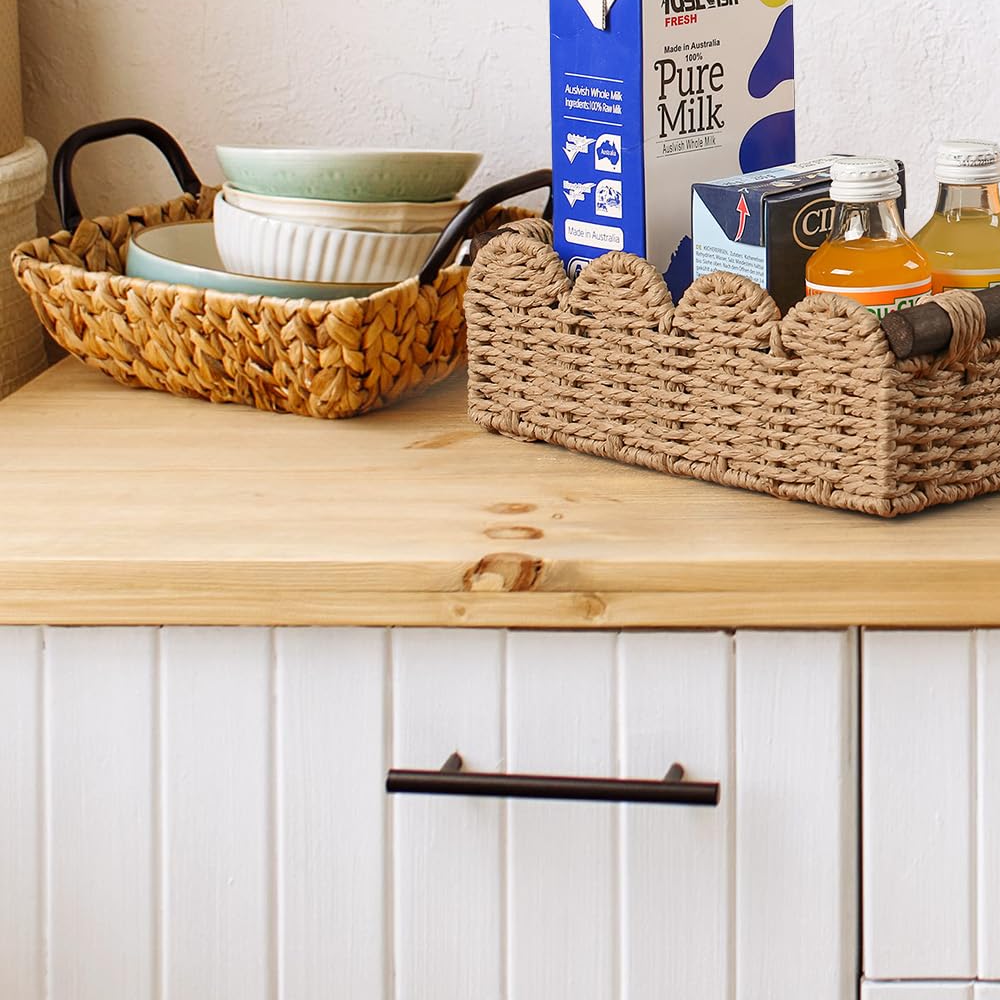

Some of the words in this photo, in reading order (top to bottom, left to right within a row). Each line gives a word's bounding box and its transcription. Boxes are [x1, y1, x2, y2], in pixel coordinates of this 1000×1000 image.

[665, 14, 698, 27] FRESH
[663, 44, 682, 54] Made
[683, 43, 690, 51] in
[690, 38, 720, 50] Australia
[685, 52, 703, 62] 100%
[654, 58, 724, 100] Pure
[590, 87, 610, 100] Whole
[610, 90, 622, 101] Milk
[657, 95, 724, 138] Milk
[685, 138, 704, 150] Whole
[704, 135, 717, 146] Milk
[568, 226, 585, 238] Made
[585, 230, 591, 239] in
[592, 230, 620, 244] Australia
